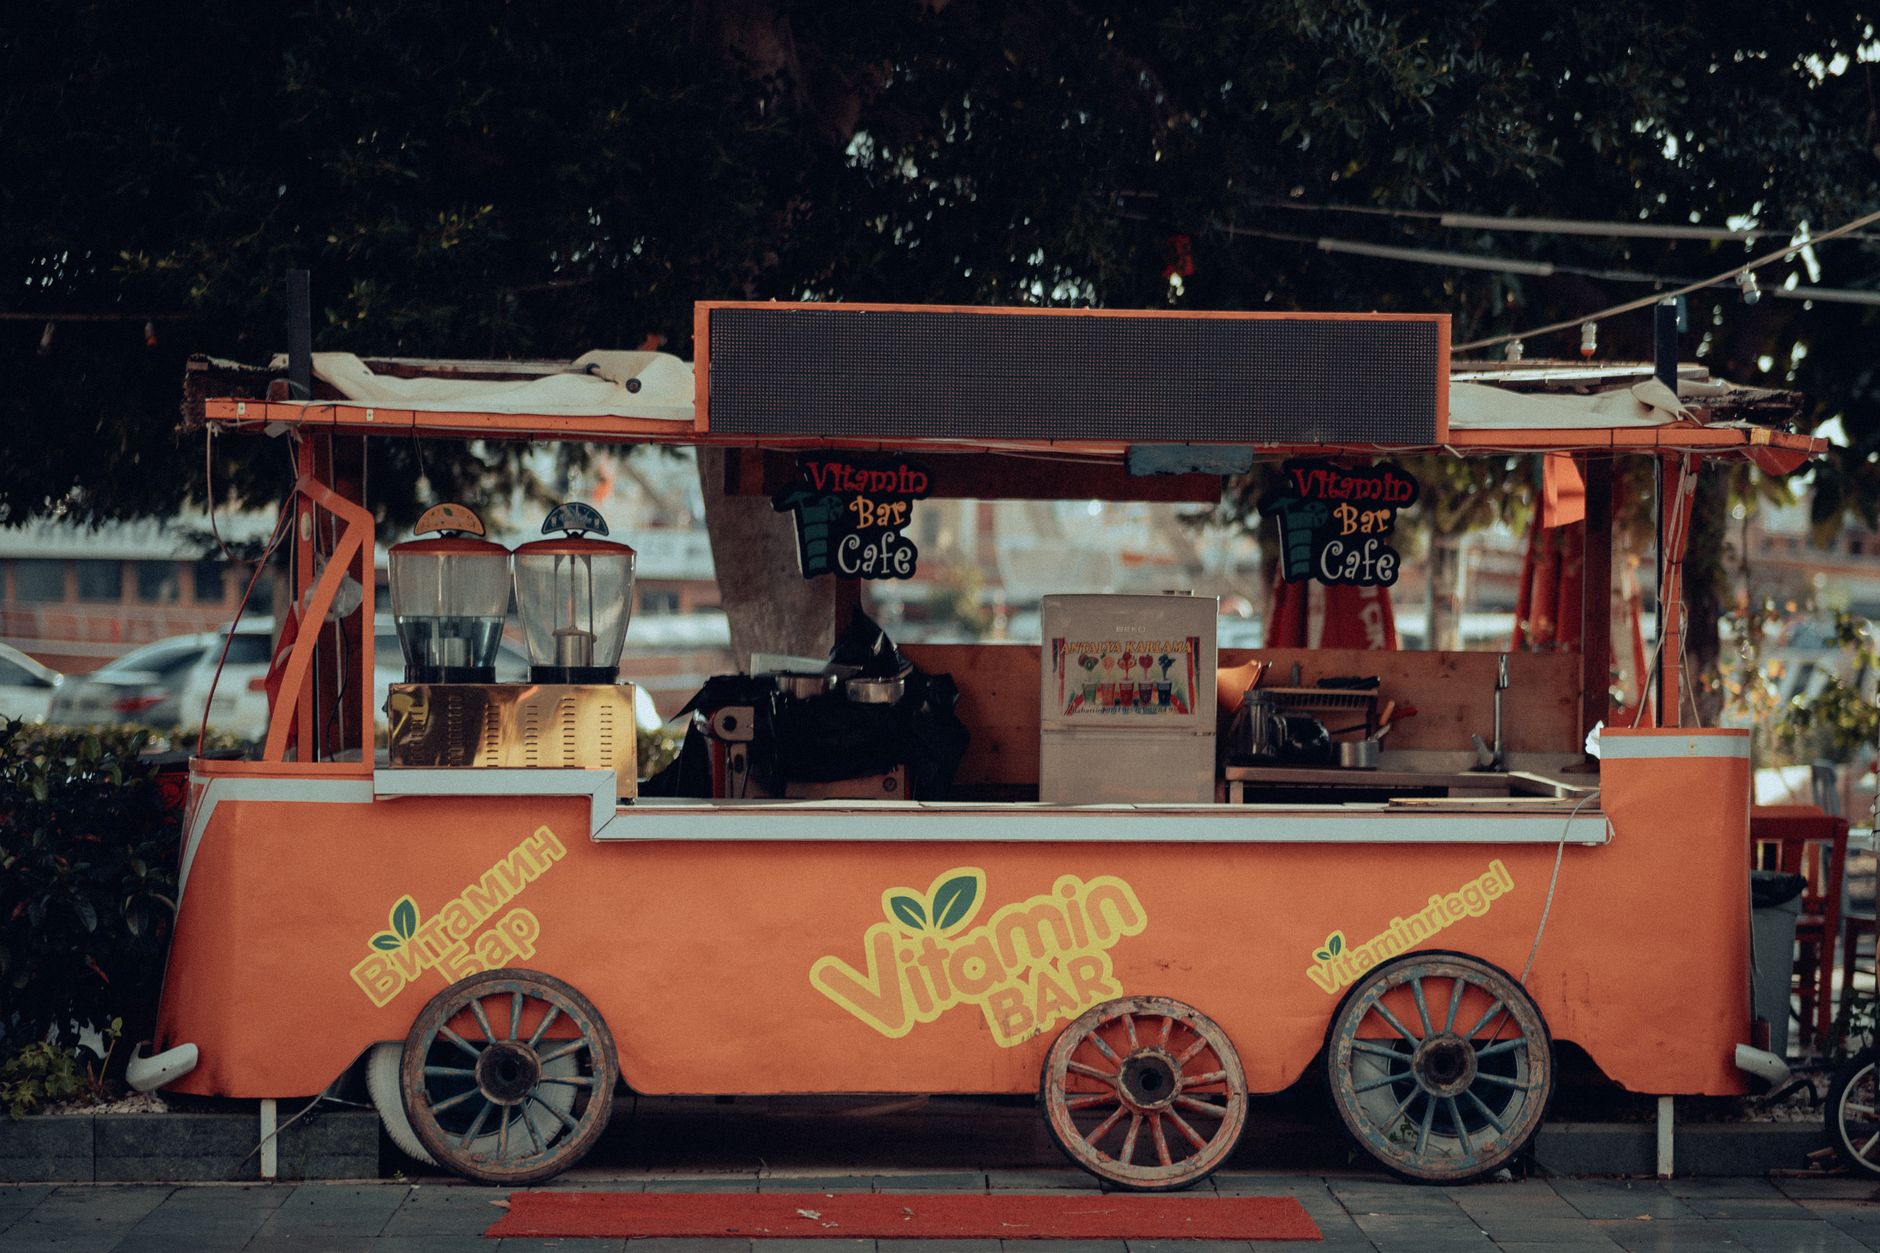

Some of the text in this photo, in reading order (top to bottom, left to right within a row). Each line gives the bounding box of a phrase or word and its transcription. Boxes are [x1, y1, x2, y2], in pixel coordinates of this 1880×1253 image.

[806, 462, 928, 492] Vitamin
[1293, 469, 1414, 501] Vitamin
[849, 495, 907, 529] Bar
[1333, 502, 1391, 536] Bar
[837, 531, 912, 574] Cafe
[1320, 538, 1395, 581] Cafe
[1061, 640, 1121, 654] ANTALYA
[1306, 859, 1515, 995] Vitaminriegel
[809, 874, 1148, 1039] Vitamin
[979, 950, 1124, 1048] BAR
